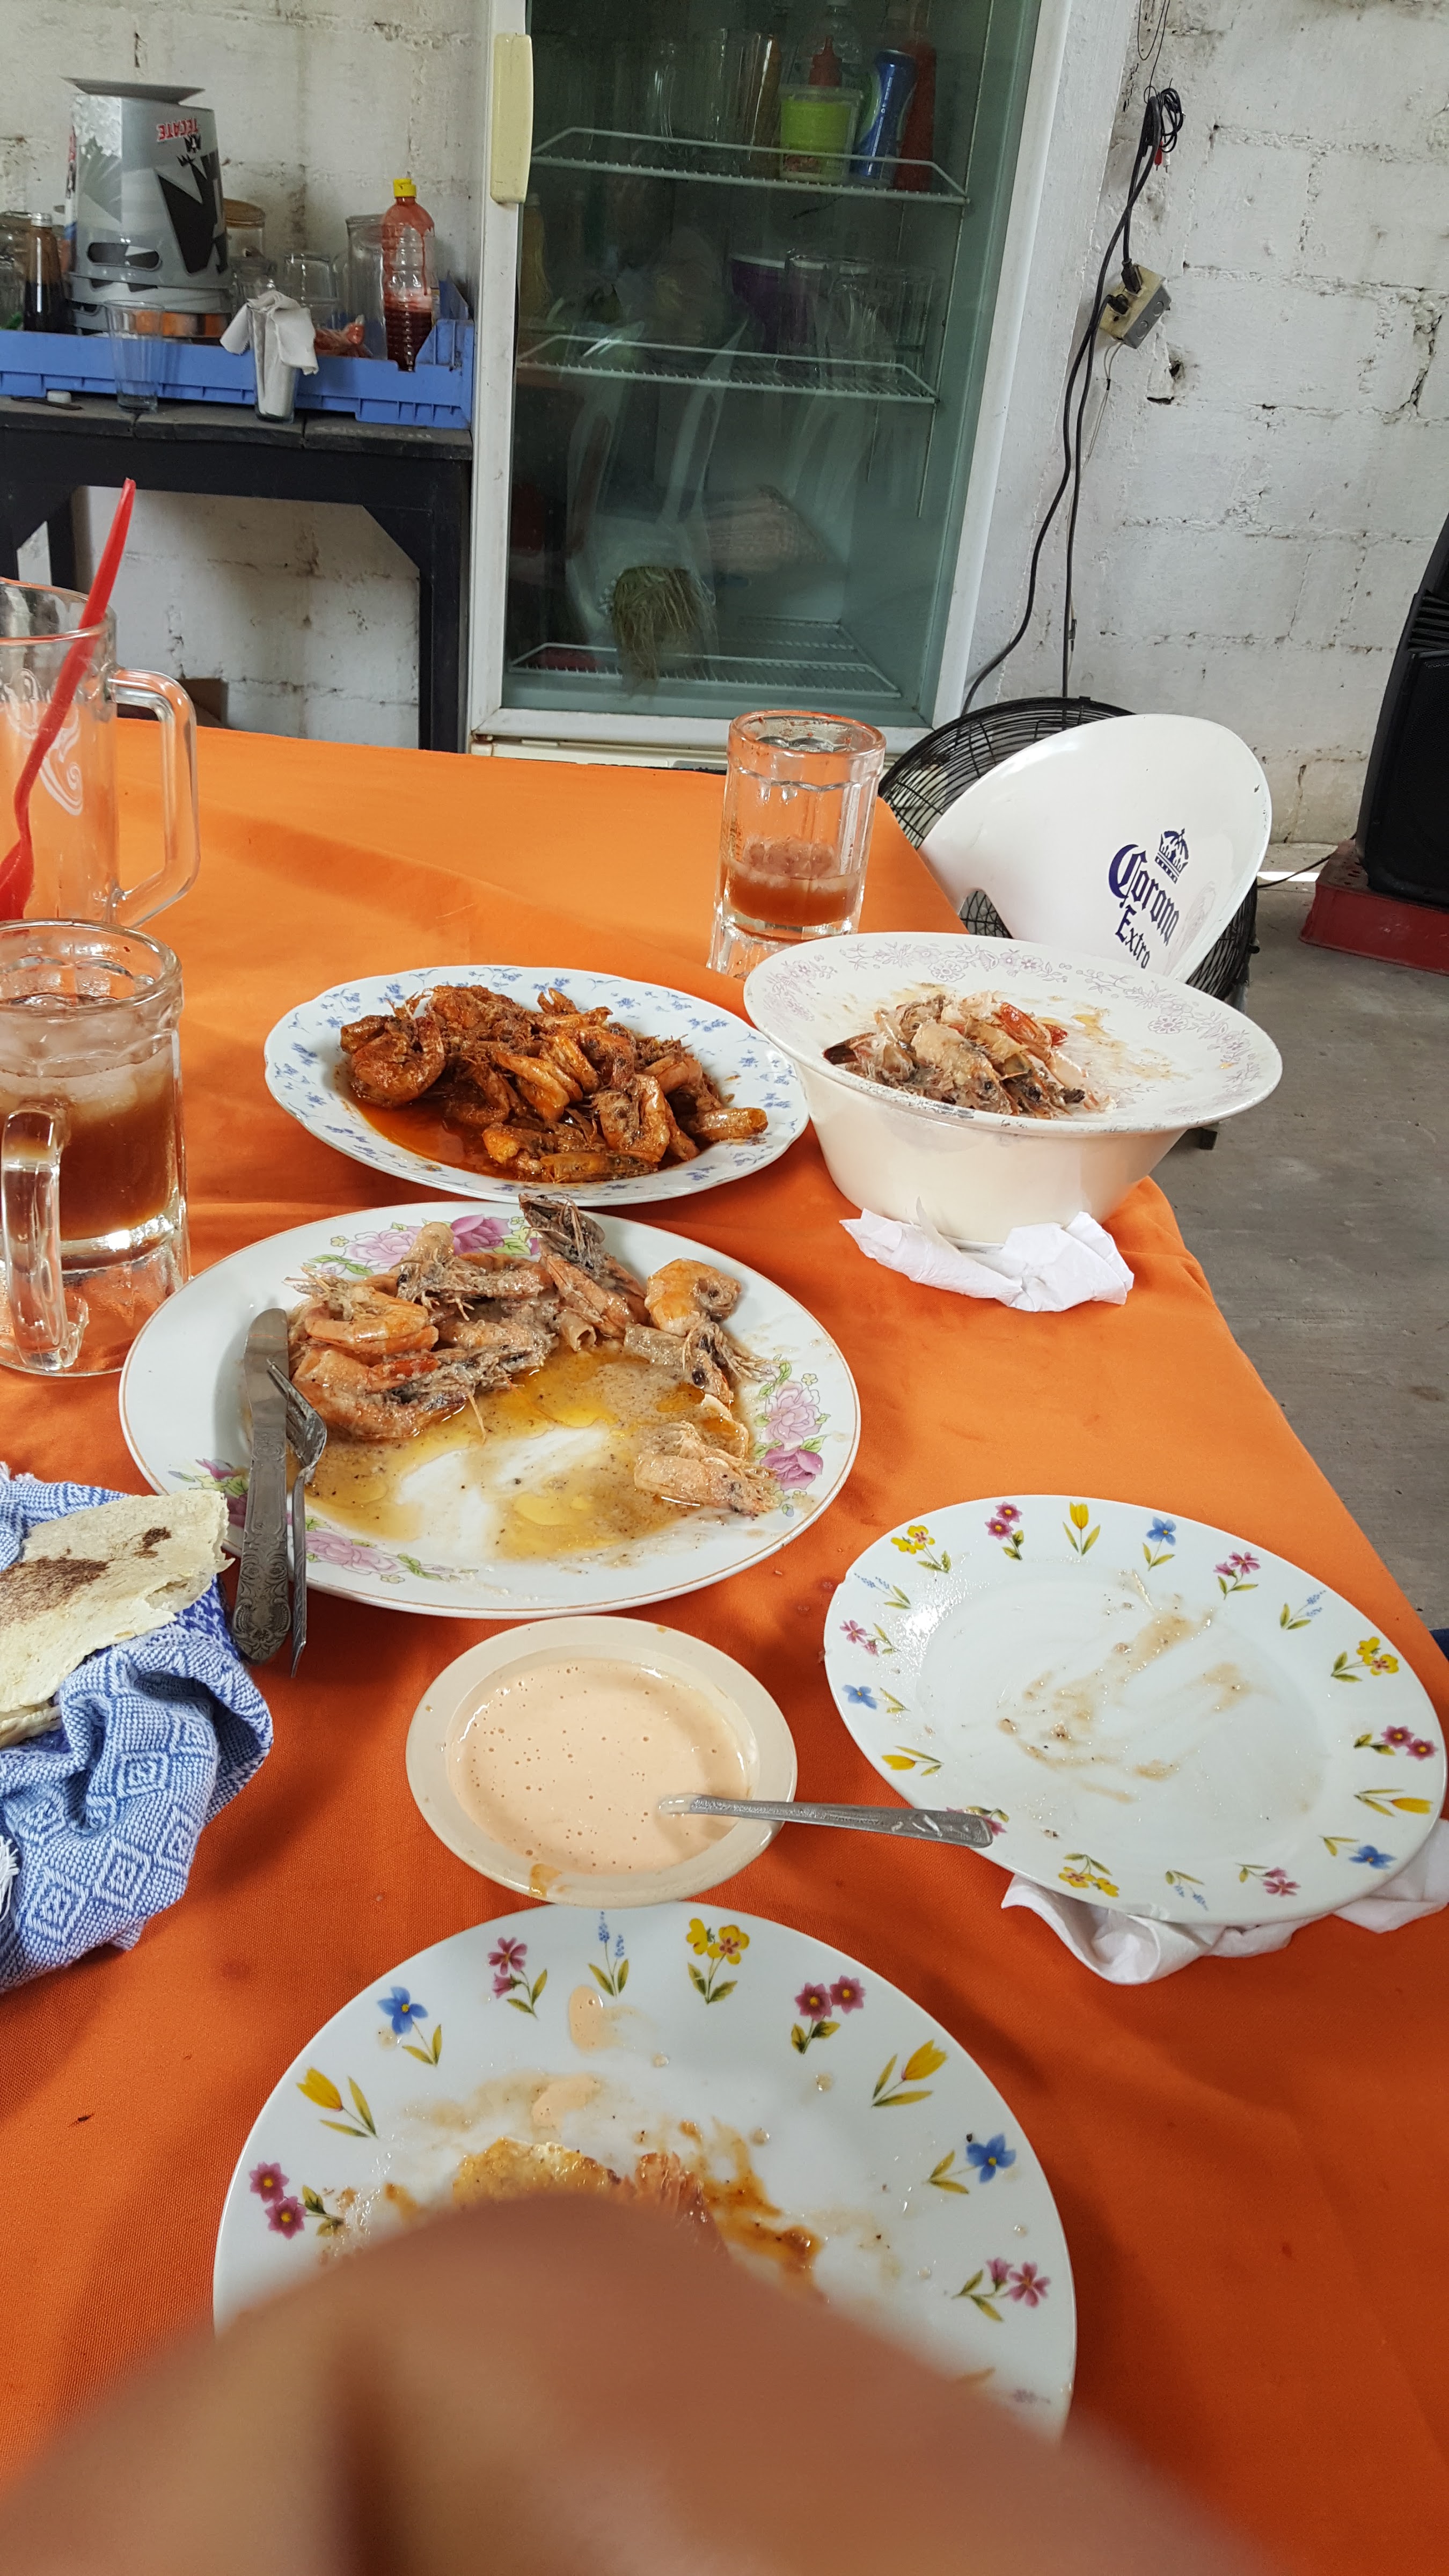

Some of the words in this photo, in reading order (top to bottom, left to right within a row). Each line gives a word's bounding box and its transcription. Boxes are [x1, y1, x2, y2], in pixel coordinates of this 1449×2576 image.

[157, 118, 198, 141] TECATE
[1109, 844, 1179, 946] Corona
[1115, 905, 1150, 969] Extra
